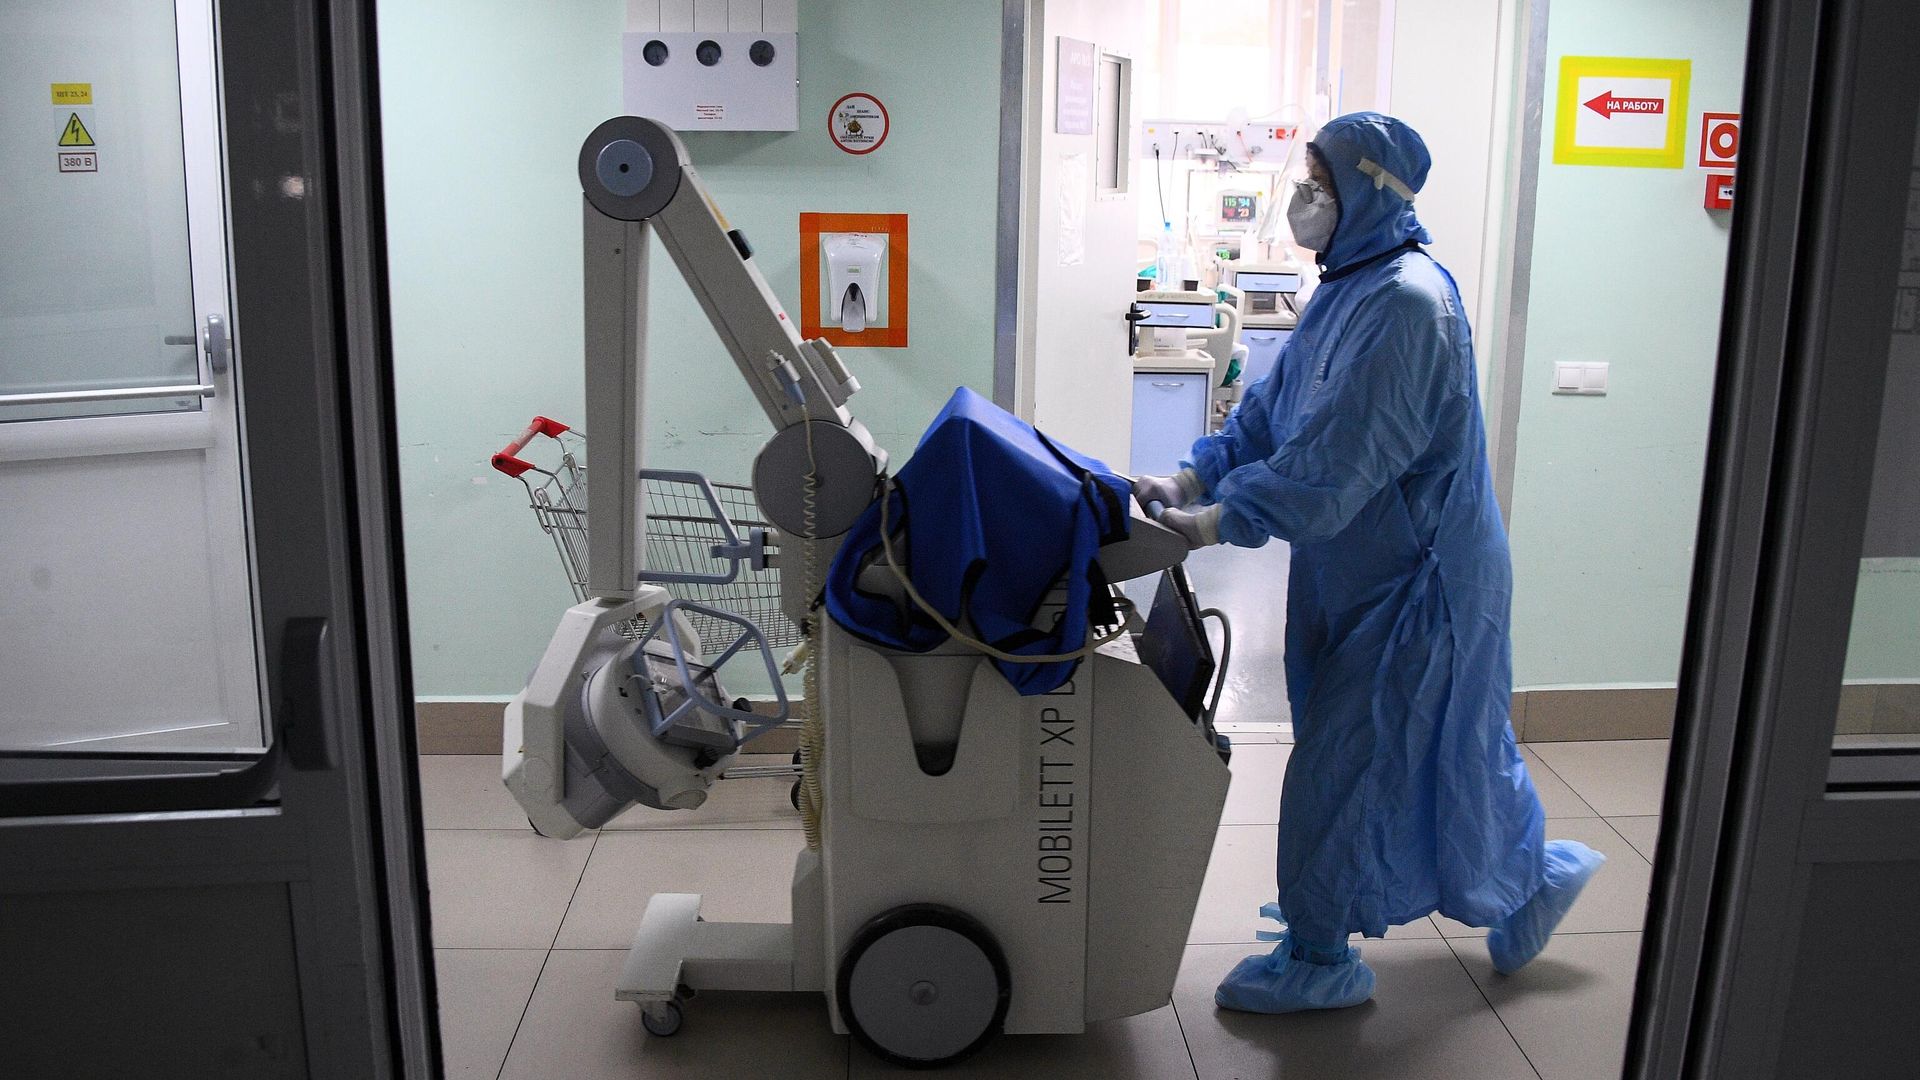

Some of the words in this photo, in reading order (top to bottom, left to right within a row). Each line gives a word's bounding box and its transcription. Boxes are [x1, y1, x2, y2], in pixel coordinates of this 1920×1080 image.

[1606, 101, 1620, 110] НА
[1623, 102, 1660, 111] РАБОТУ
[64, 158, 81, 167] 380
[85, 158, 92, 166] В
[1041, 707, 1075, 746] XP
[1038, 756, 1073, 903] MOBILETT
